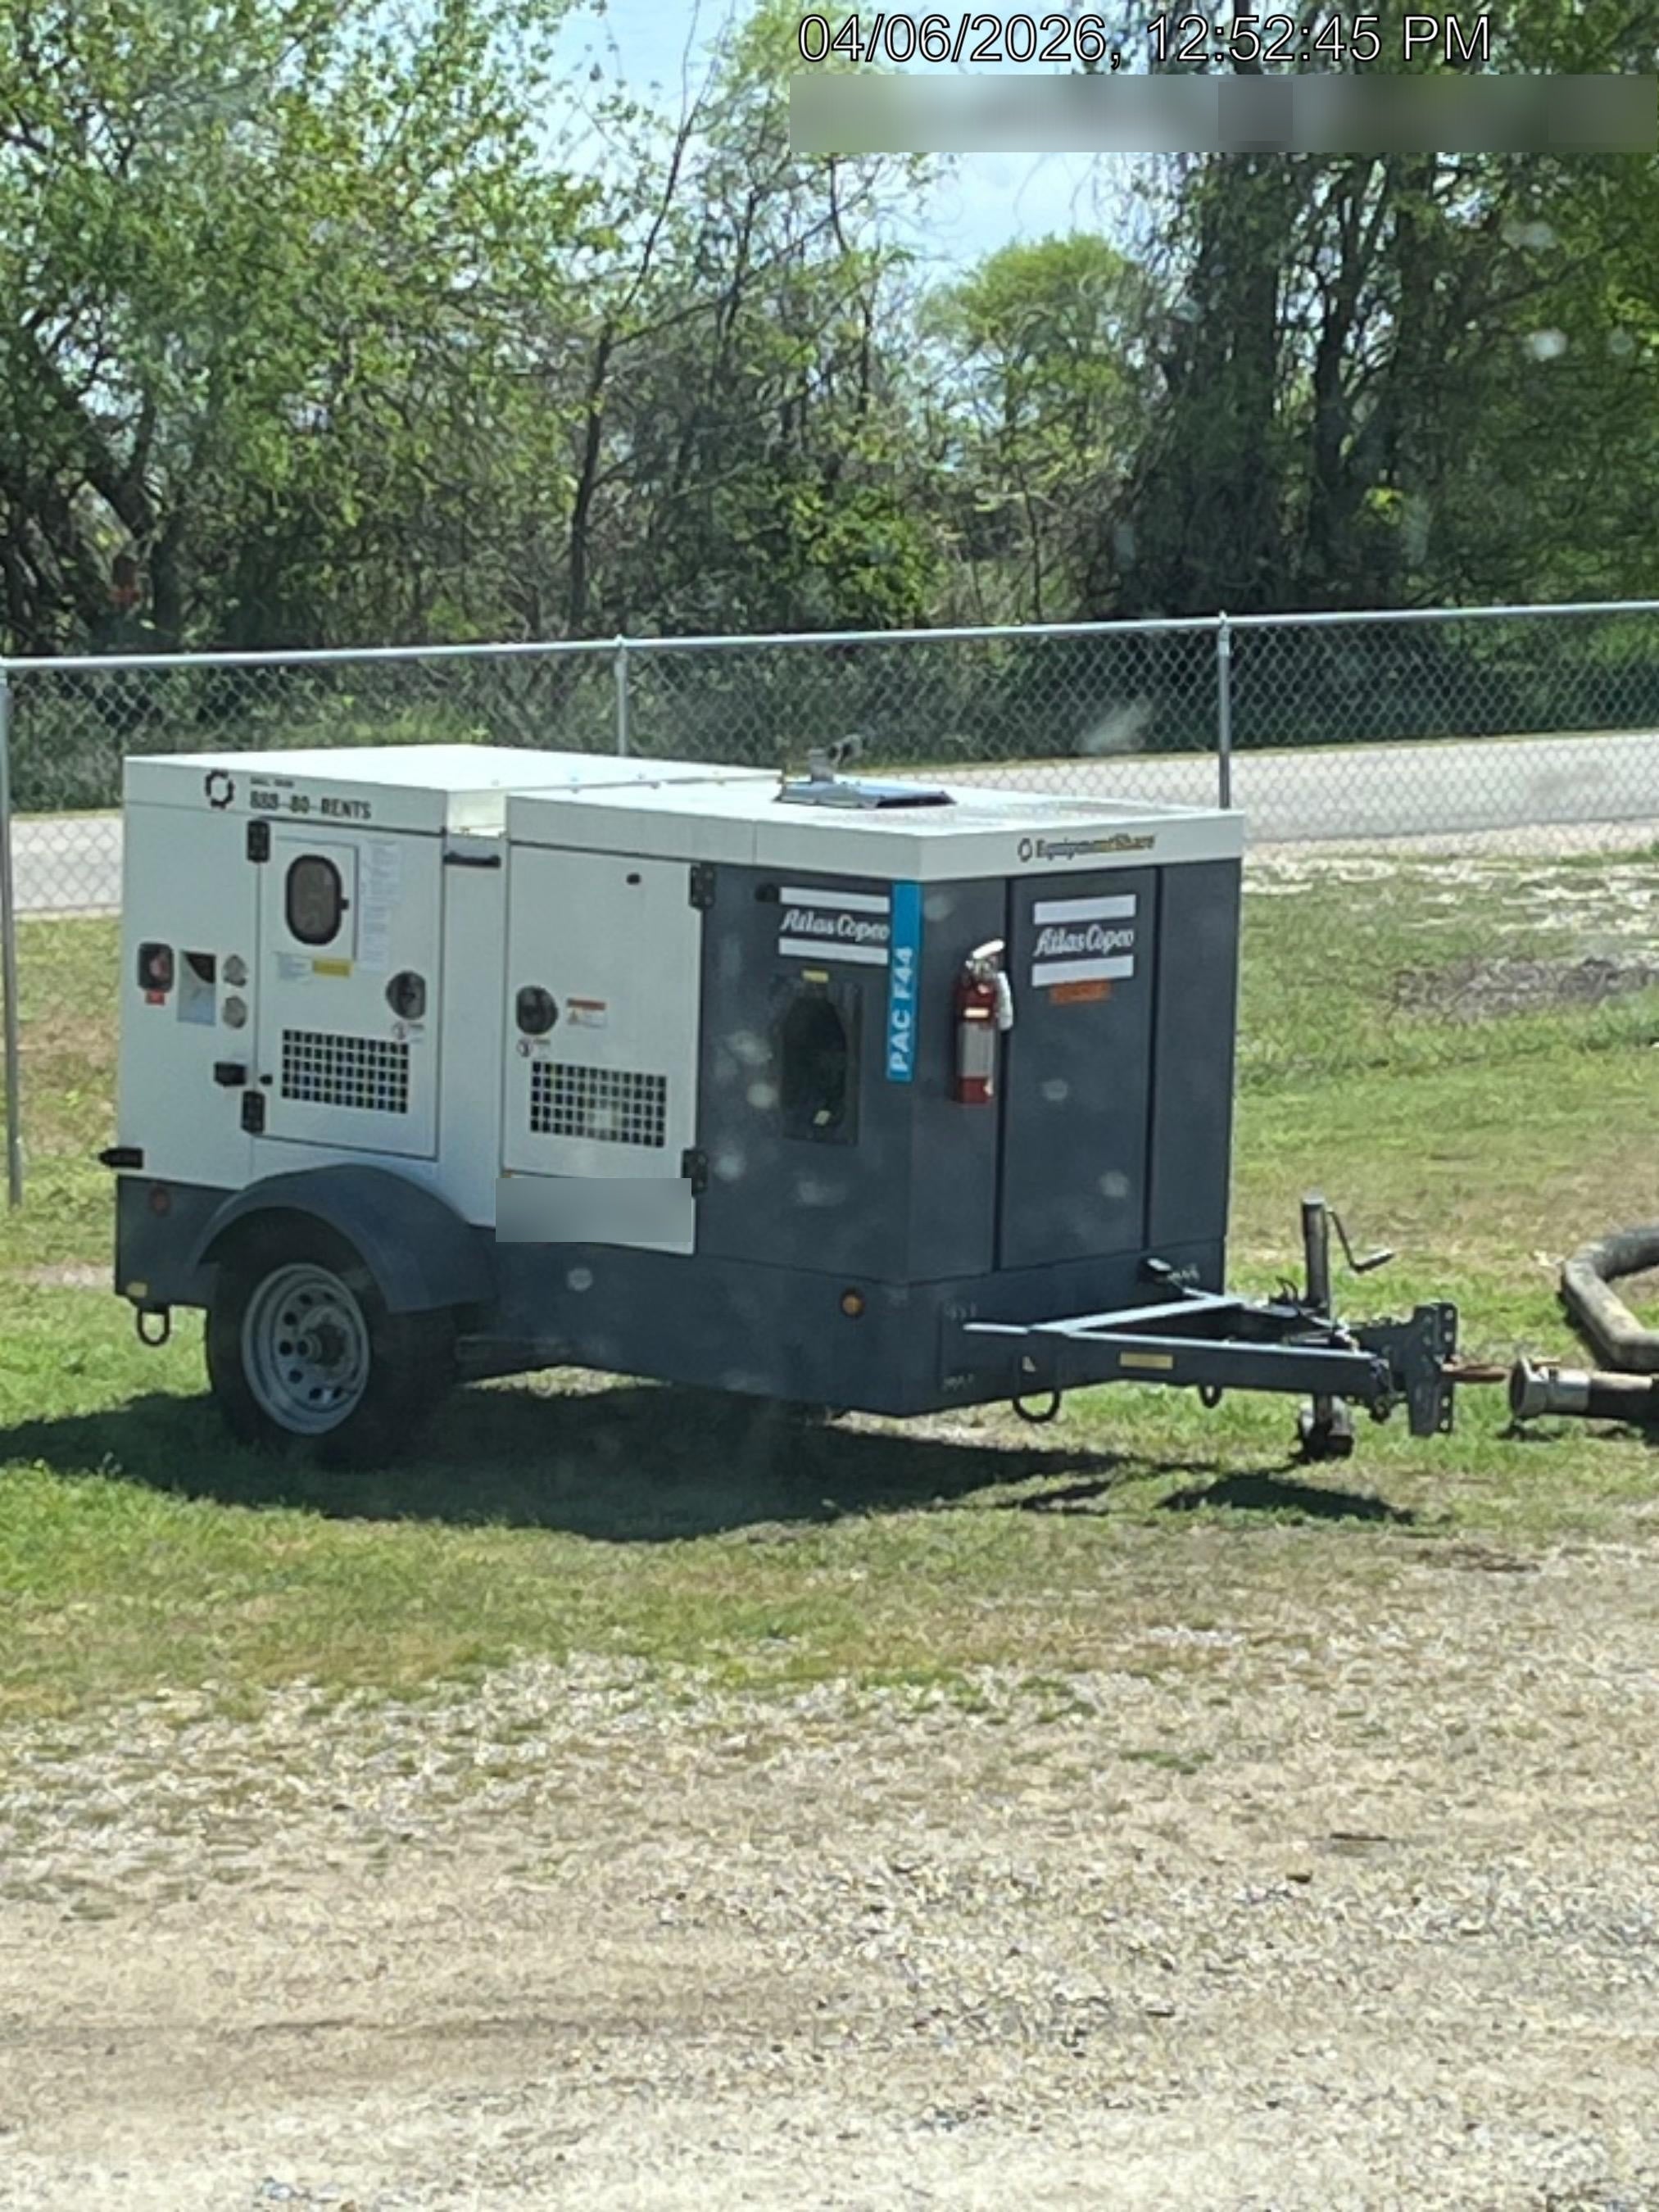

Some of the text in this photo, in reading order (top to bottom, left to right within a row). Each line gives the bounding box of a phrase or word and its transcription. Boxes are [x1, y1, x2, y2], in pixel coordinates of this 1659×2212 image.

[780, 909, 891, 942] Atlas Copco
[1033, 923, 1134, 957] Atlas Copco
[890, 947, 913, 1072] PAC F44
